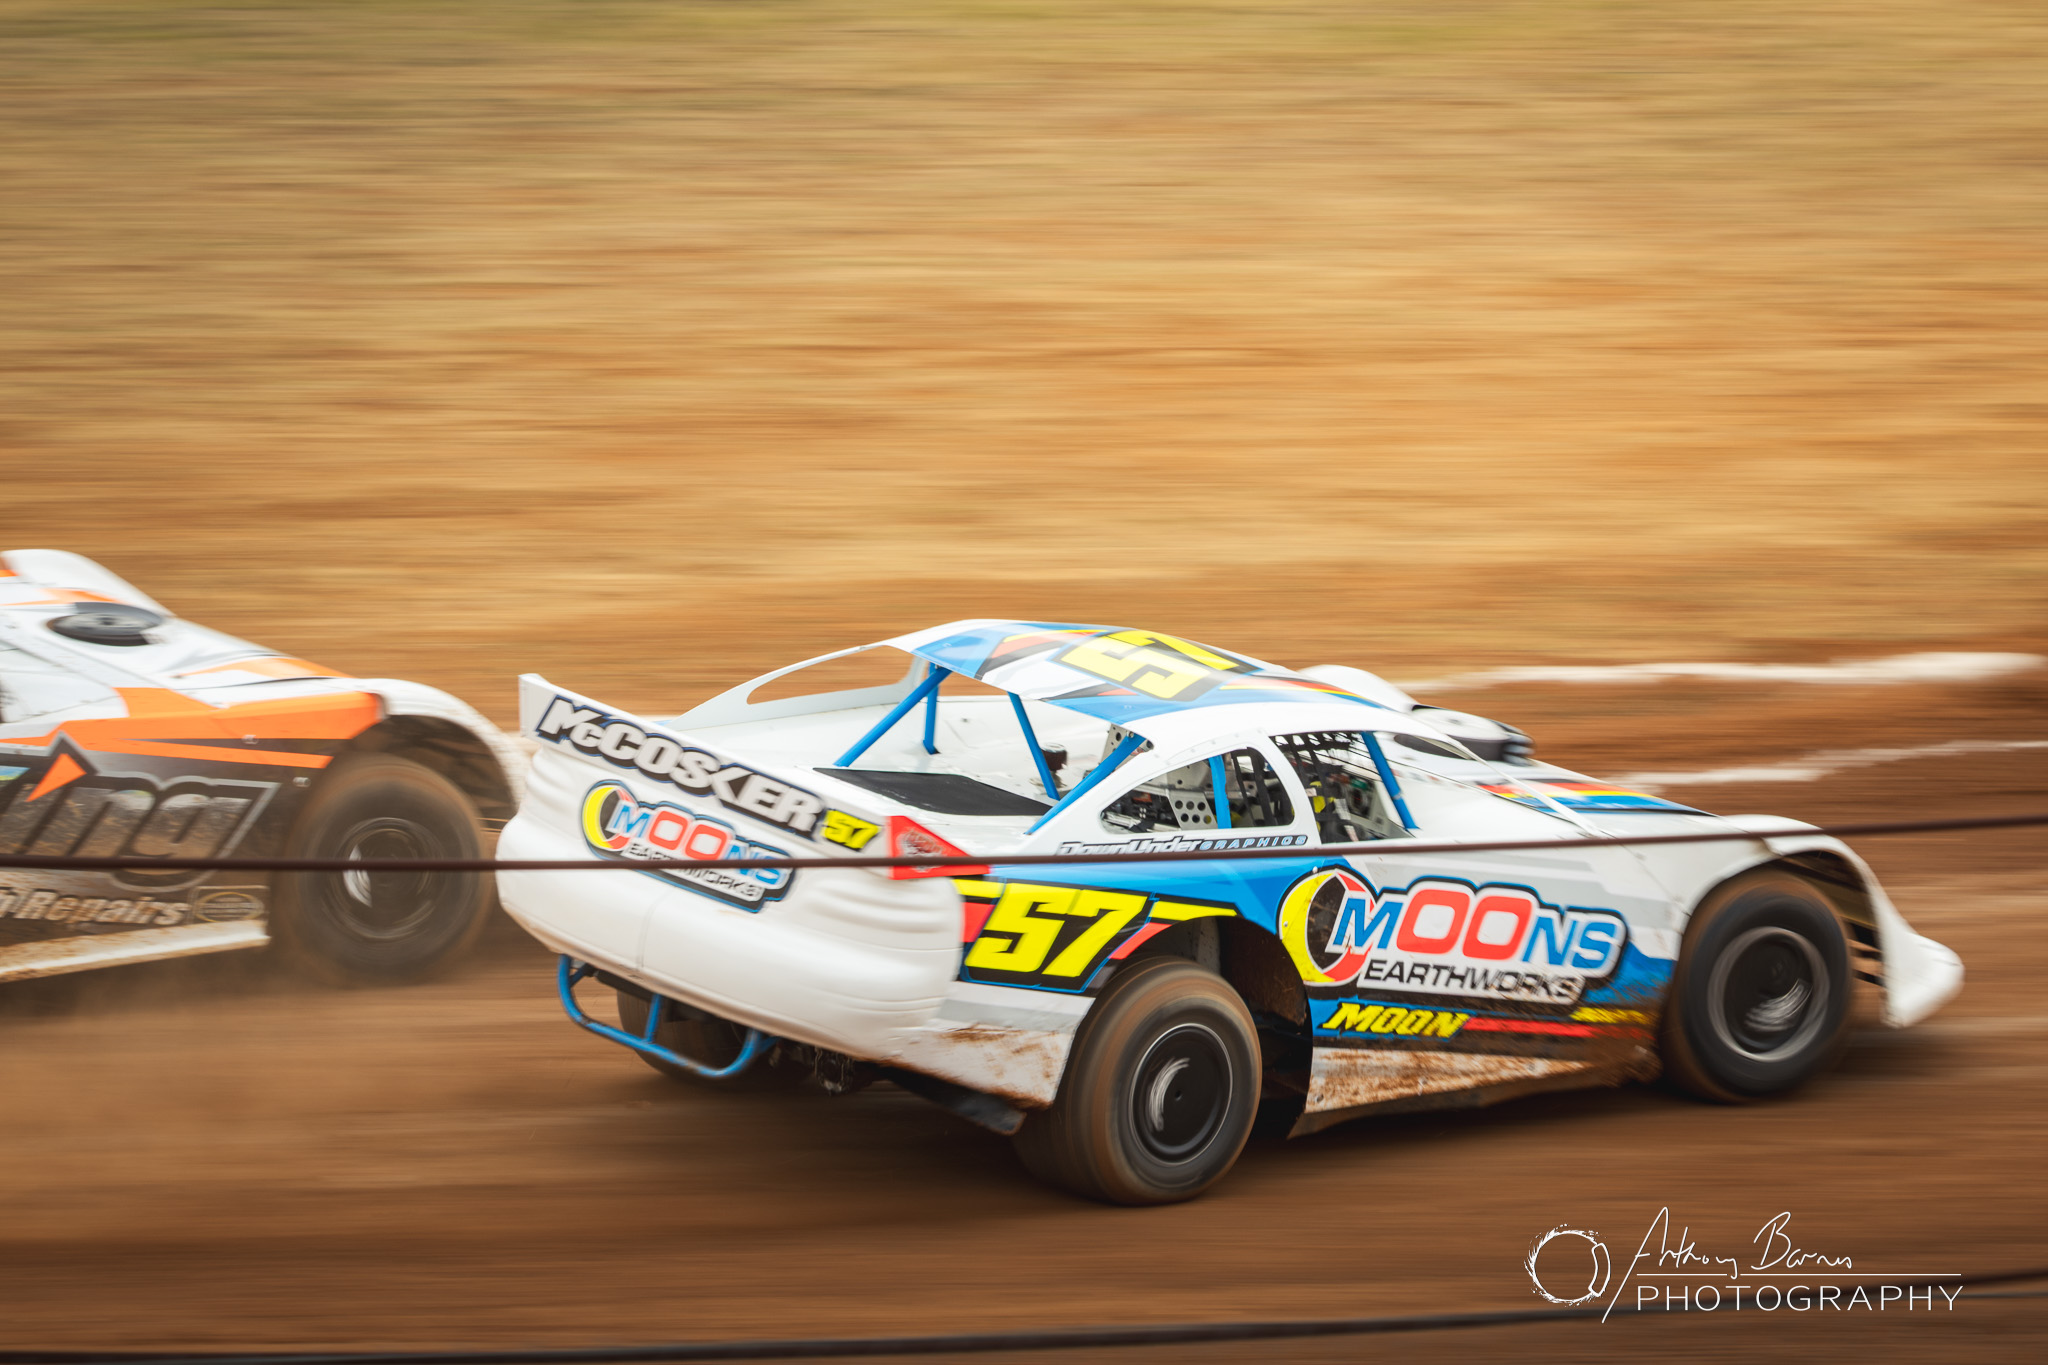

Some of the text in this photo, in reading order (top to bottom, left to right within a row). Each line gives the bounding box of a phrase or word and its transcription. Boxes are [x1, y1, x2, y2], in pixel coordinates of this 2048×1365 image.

[1060, 630, 1239, 699] 57
[538, 697, 824, 836] McCOSKER
[821, 809, 881, 851] 57
[613, 805, 781, 886] MOONS
[15, 889, 191, 926] Repairs
[966, 883, 1148, 977] 57
[1333, 889, 1619, 969] MOONS
[1364, 959, 1577, 998] EARTHWORKS
[1322, 1003, 1471, 1038] MOON
